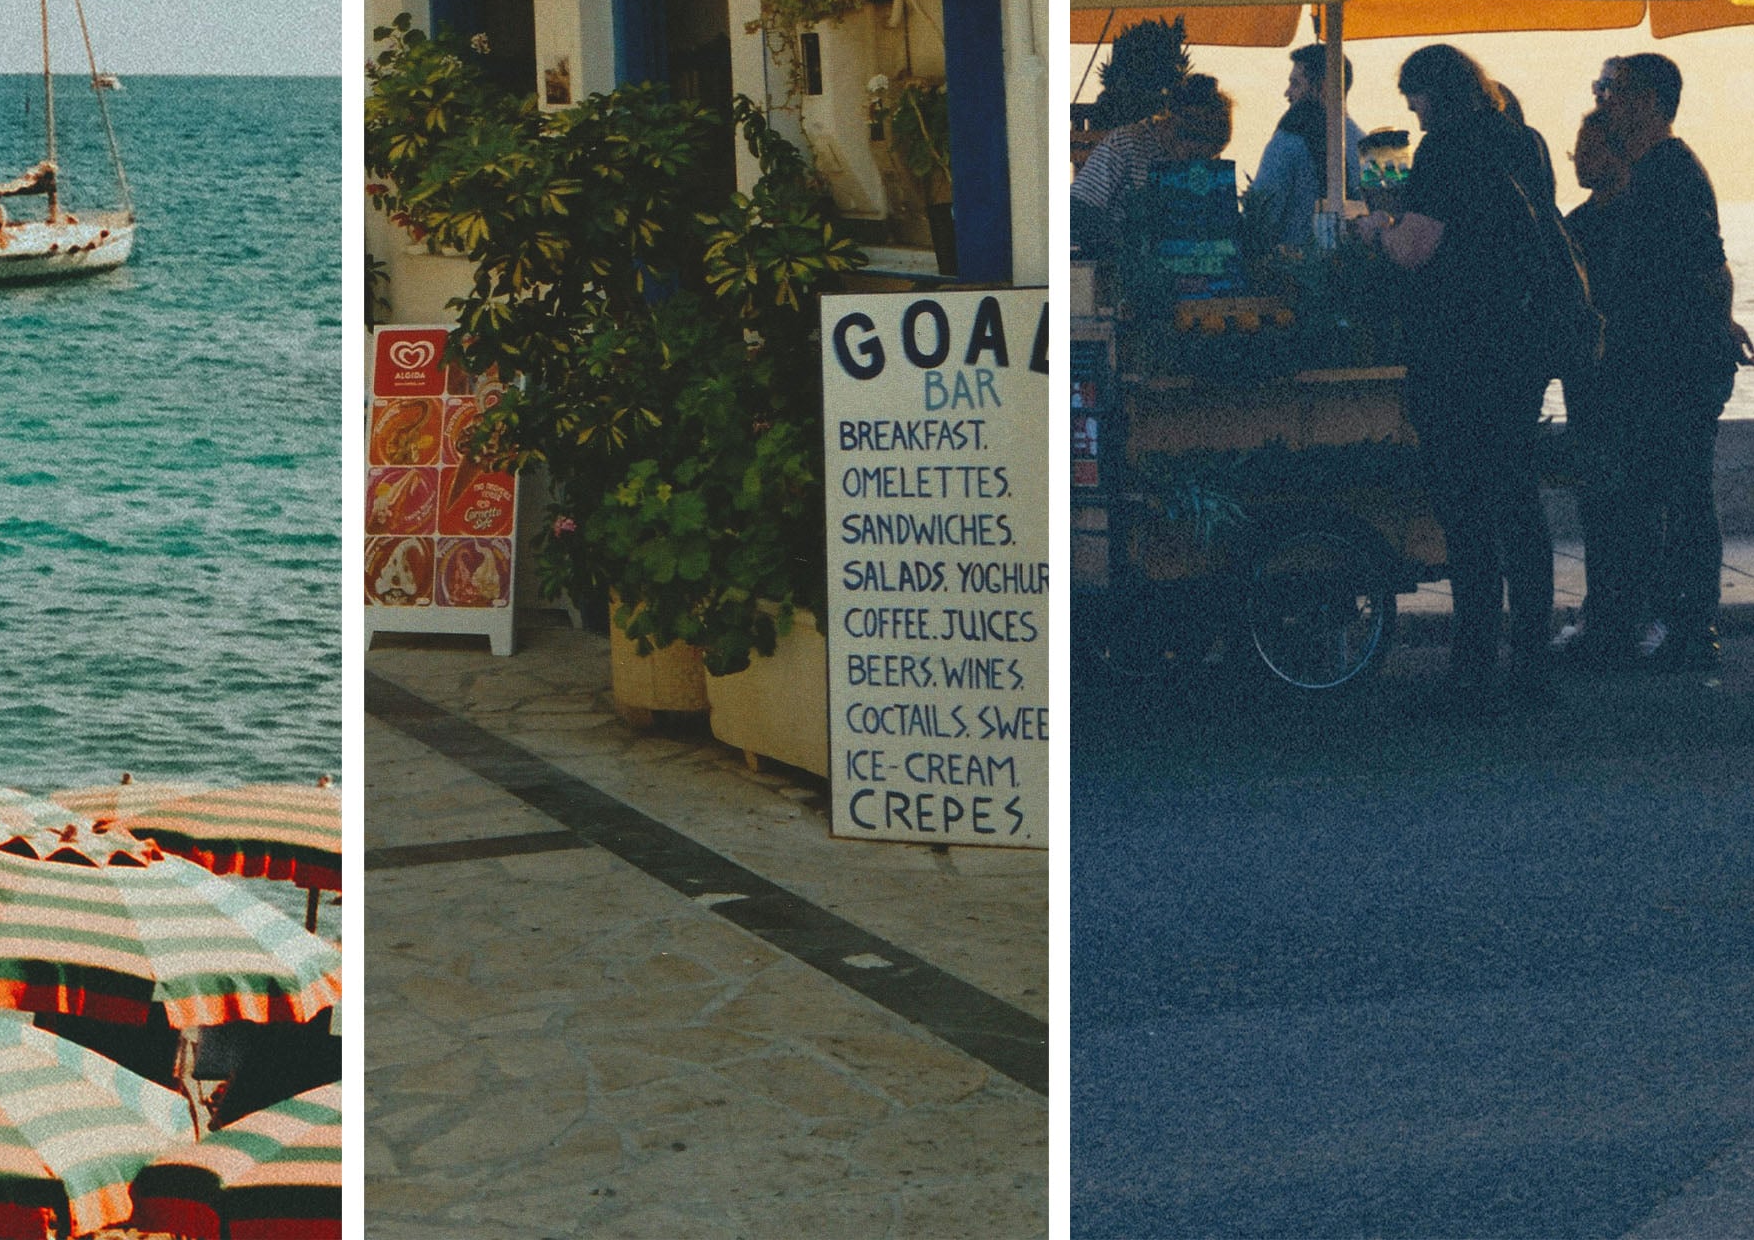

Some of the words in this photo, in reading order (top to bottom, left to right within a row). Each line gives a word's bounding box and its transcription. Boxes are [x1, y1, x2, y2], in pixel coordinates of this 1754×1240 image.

[394, 371, 426, 380] ALGIDA
[924, 368, 1002, 412] BAR
[839, 419, 989, 452] BREAKFAST.
[842, 465, 1014, 500] OMELETTES.
[841, 512, 1017, 547] SANDWICHES.
[842, 560, 949, 594] SALADS.
[845, 750, 1021, 790] ICE-CREAM.
[849, 788, 1032, 840] CREPES.
